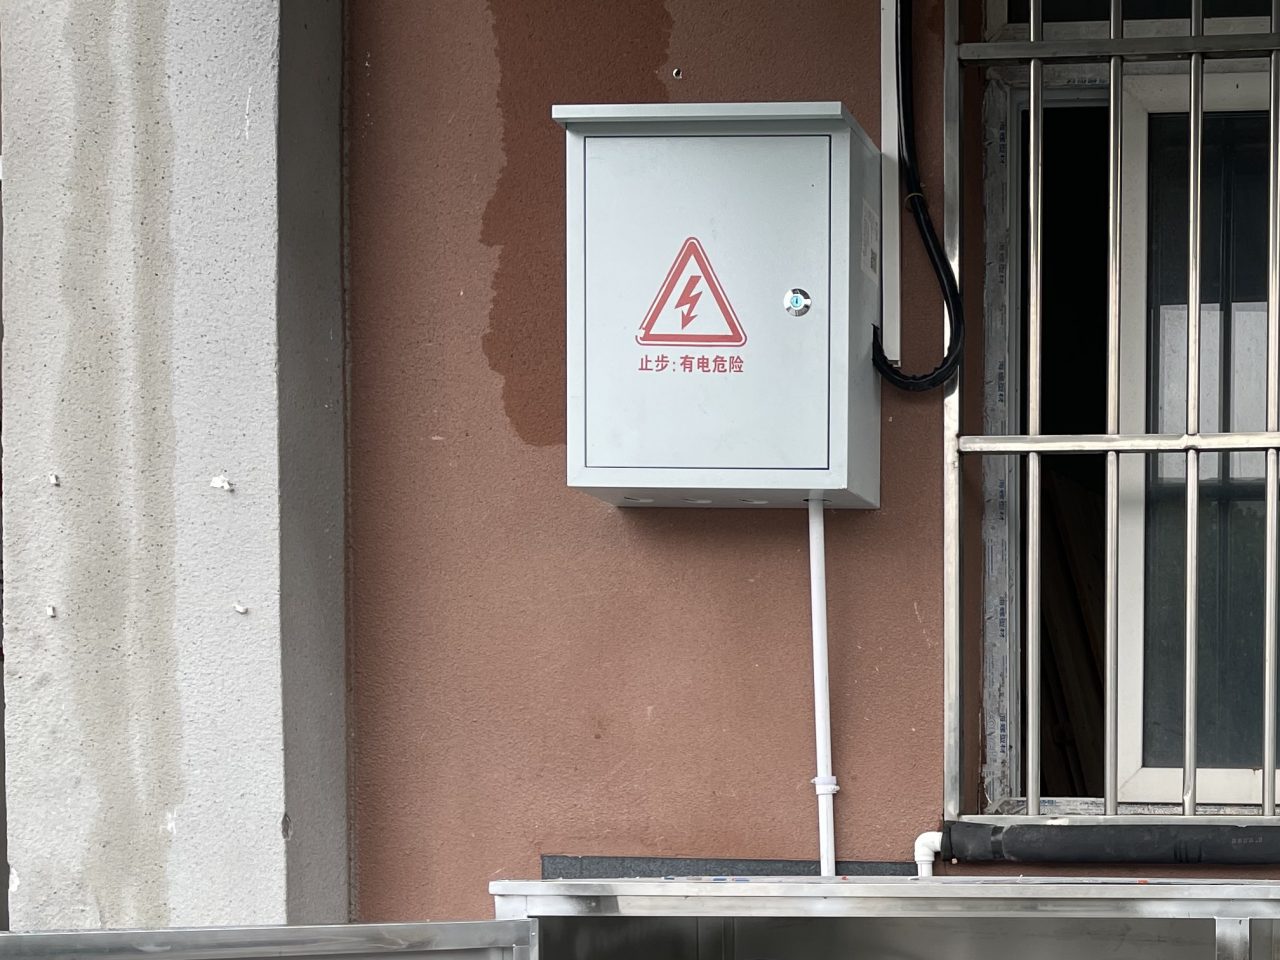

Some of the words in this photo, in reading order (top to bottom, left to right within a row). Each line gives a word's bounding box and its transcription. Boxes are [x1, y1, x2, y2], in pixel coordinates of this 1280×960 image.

[638, 354, 744, 373] 止步:有电危险
